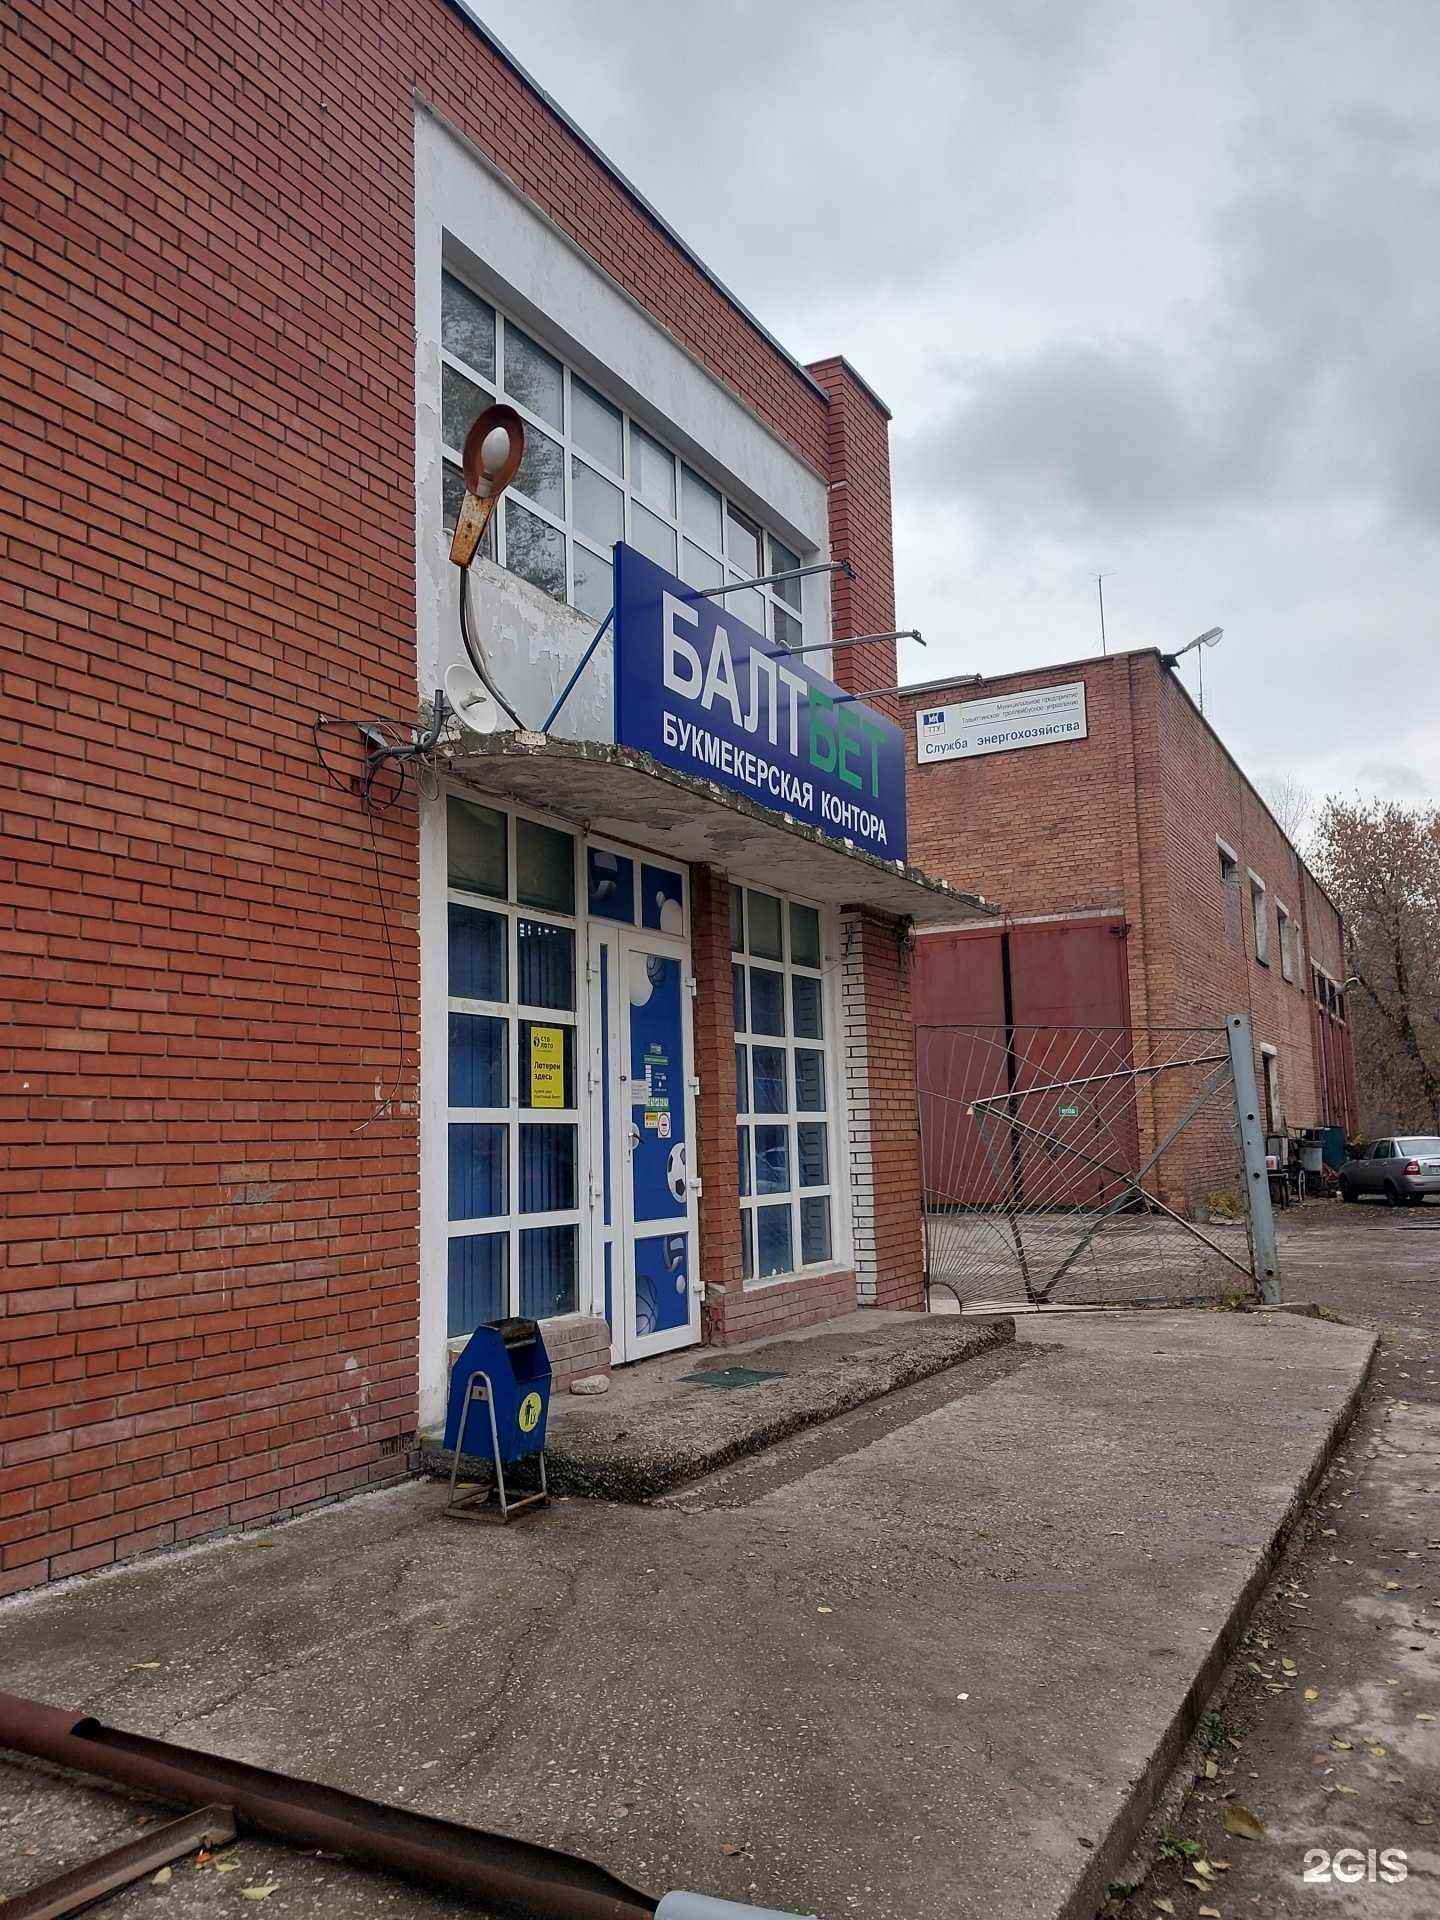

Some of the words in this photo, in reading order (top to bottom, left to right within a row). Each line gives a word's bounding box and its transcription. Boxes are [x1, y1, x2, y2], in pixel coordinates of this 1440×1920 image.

[925, 738, 968, 755] Служба
[976, 720, 1080, 747] энергохозяйства
[663, 711, 813, 811] БУКМЕКЕРСКАЯ
[821, 790, 888, 846] КОНТОРА
[534, 1061, 561, 1071] Лотереи
